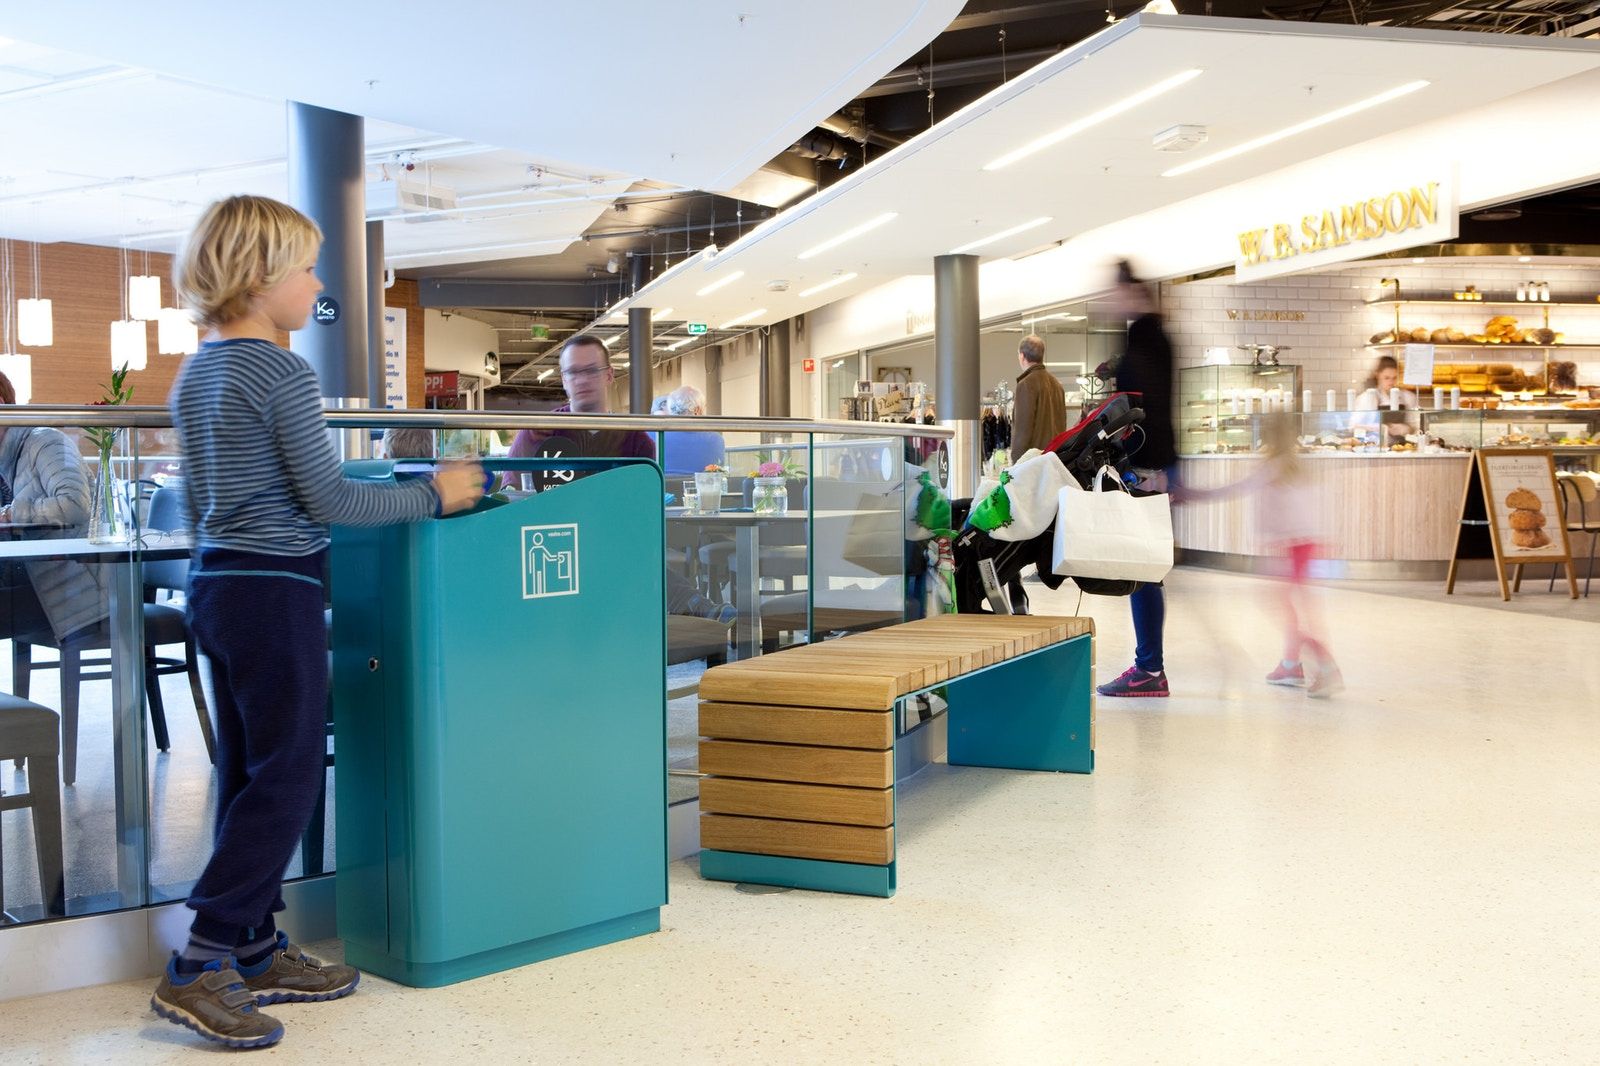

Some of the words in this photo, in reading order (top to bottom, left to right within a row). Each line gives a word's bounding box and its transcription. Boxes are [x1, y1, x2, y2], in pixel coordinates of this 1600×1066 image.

[1238, 229, 1268, 265] W.
[1272, 223, 1298, 260] B.
[1301, 181, 1440, 253] SAMSON
